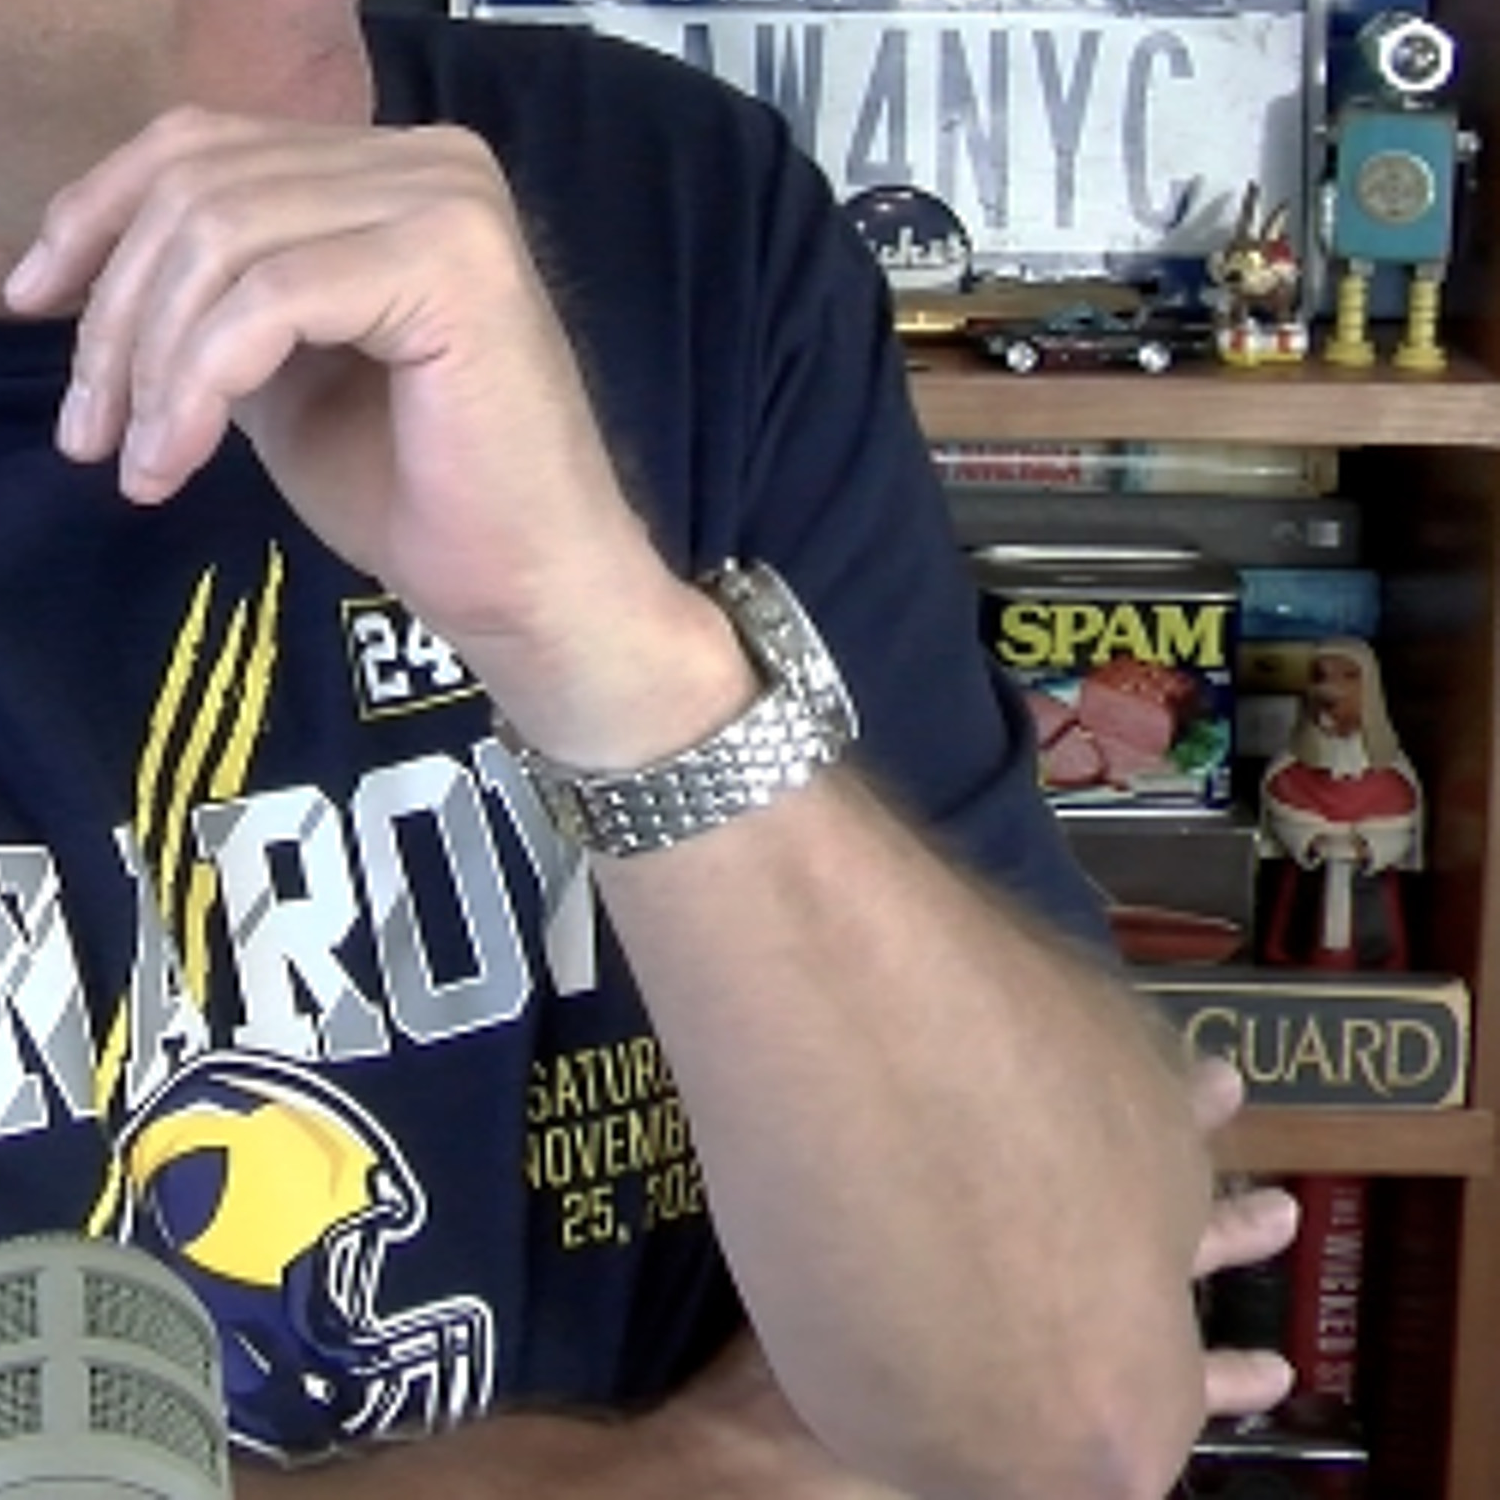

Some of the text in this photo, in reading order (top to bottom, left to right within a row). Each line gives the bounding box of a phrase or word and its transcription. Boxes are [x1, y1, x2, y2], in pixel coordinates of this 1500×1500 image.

[353, 610, 464, 702] 24
[996, 602, 1234, 668] SPAM
[1183, 1006, 1442, 1096] GUARD
[562, 1184, 632, 1250] 25,
[1317, 1234, 1363, 1353] WICKED
